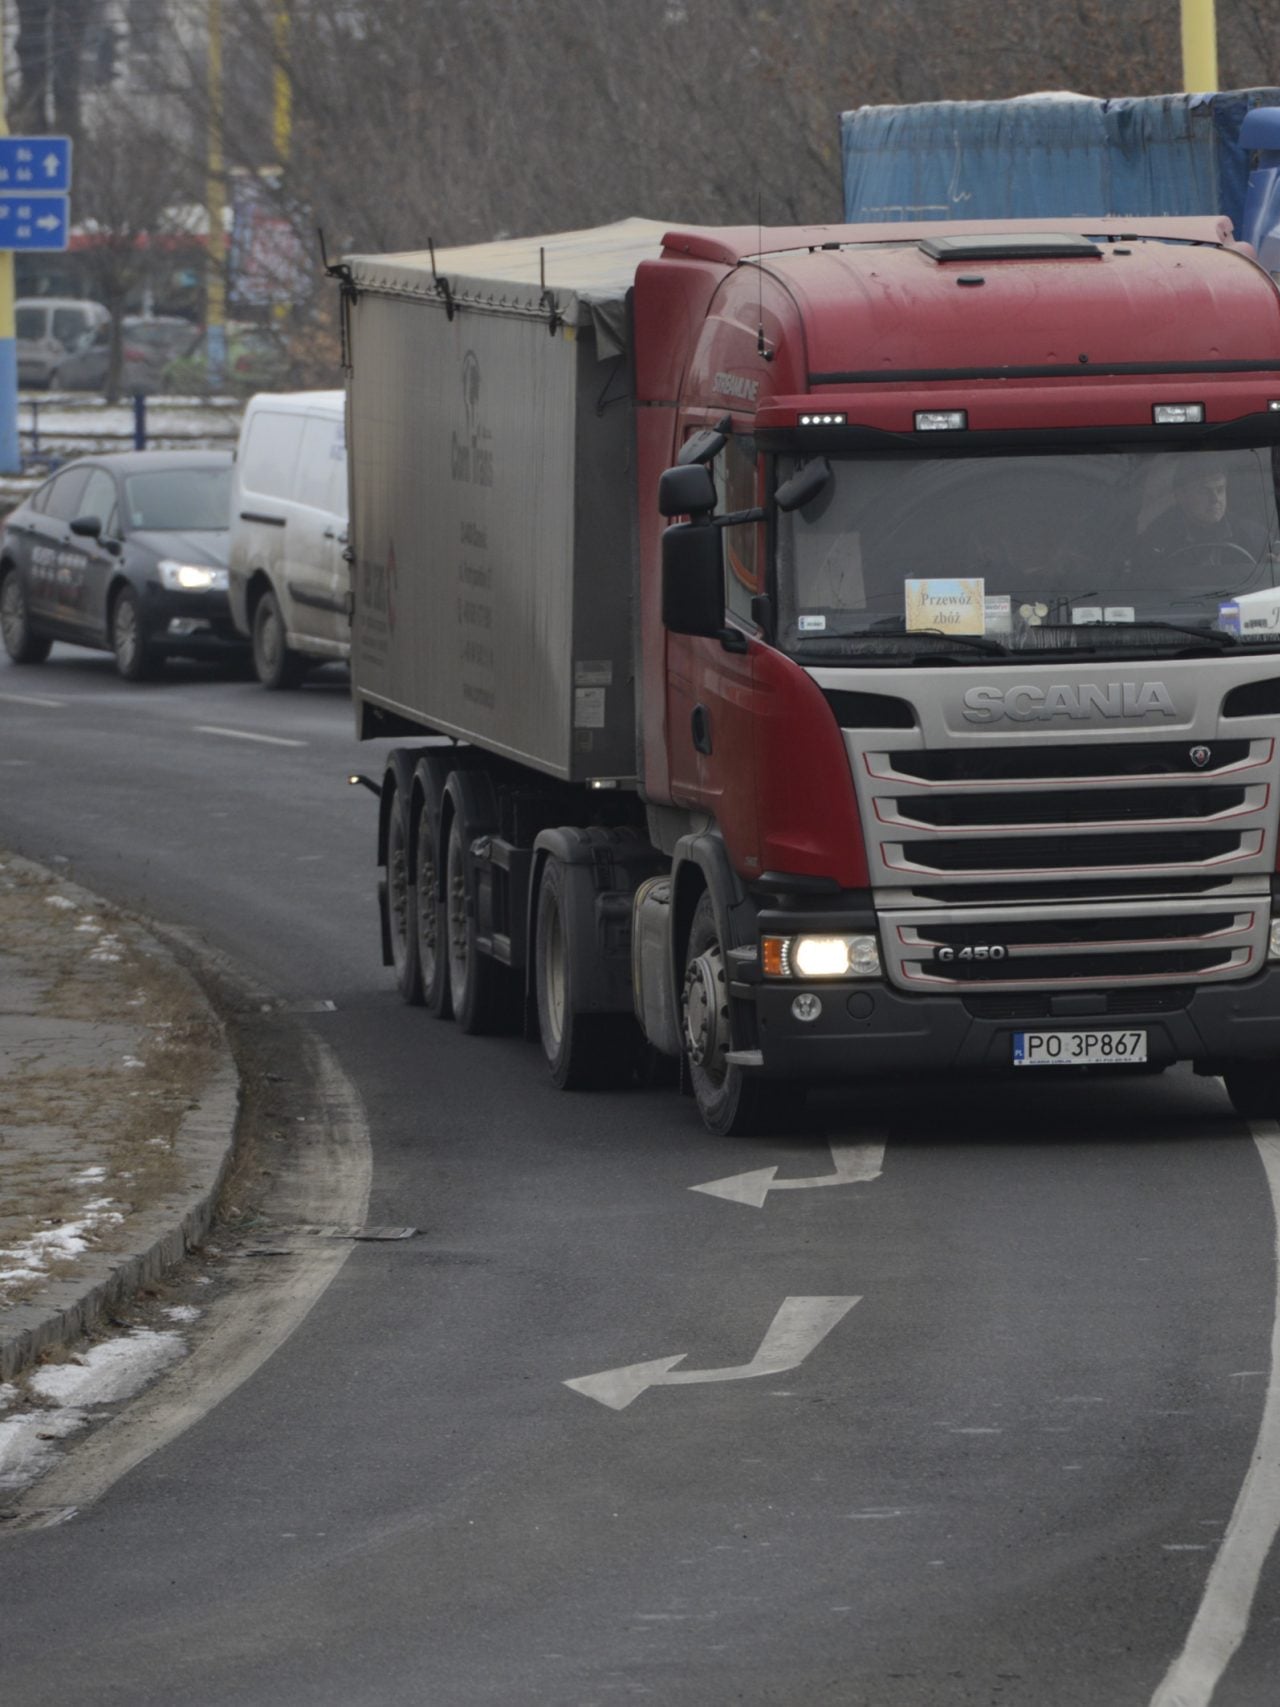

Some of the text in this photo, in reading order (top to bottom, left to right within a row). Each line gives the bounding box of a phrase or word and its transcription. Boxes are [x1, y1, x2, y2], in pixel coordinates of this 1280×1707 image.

[962, 681, 1177, 724] SCANIA
[938, 945, 1006, 962] G 450
[1028, 1033, 1142, 1058] PO 3P867
